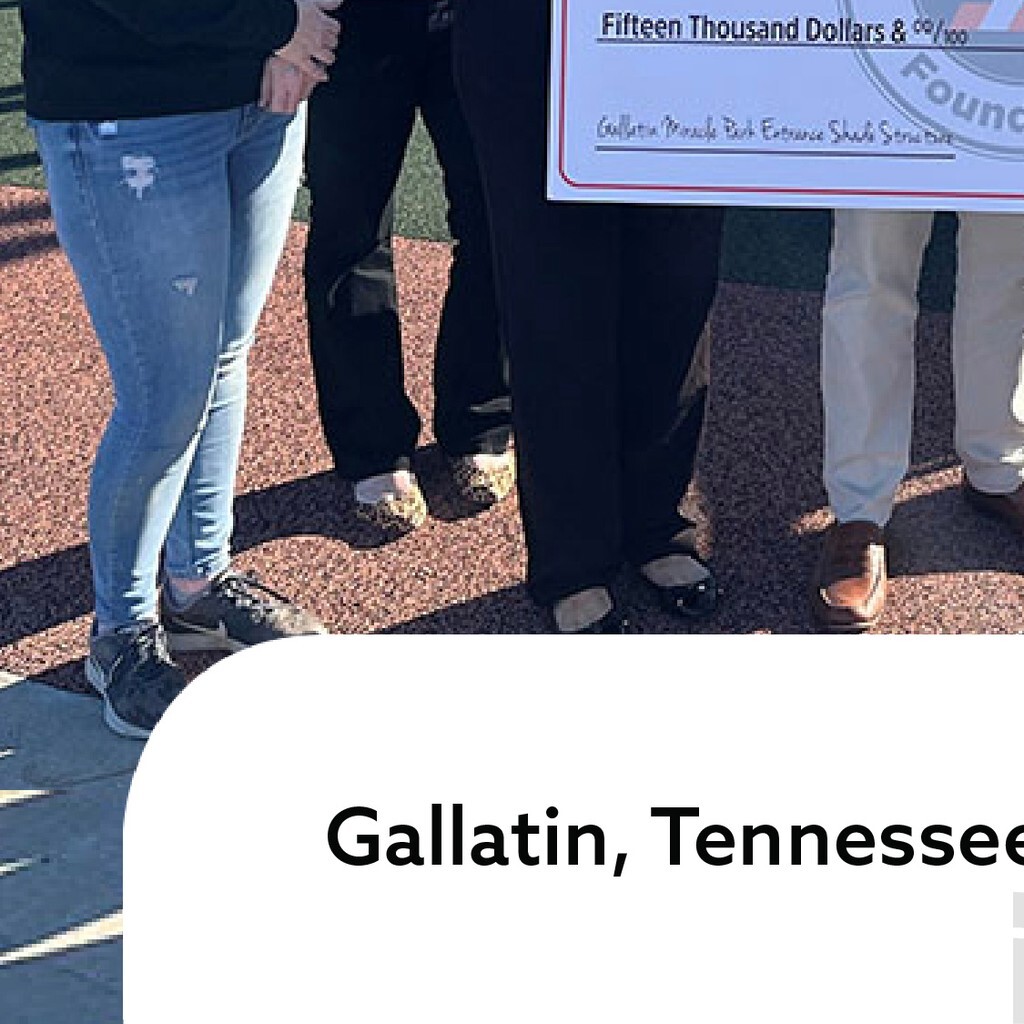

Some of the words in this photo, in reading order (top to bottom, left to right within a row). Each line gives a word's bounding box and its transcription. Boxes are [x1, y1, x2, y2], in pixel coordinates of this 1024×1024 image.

[601, 12, 682, 37] Fifteen
[688, 14, 799, 40] Thousand
[806, 17, 885, 42] Dollars
[891, 18, 906, 42] &
